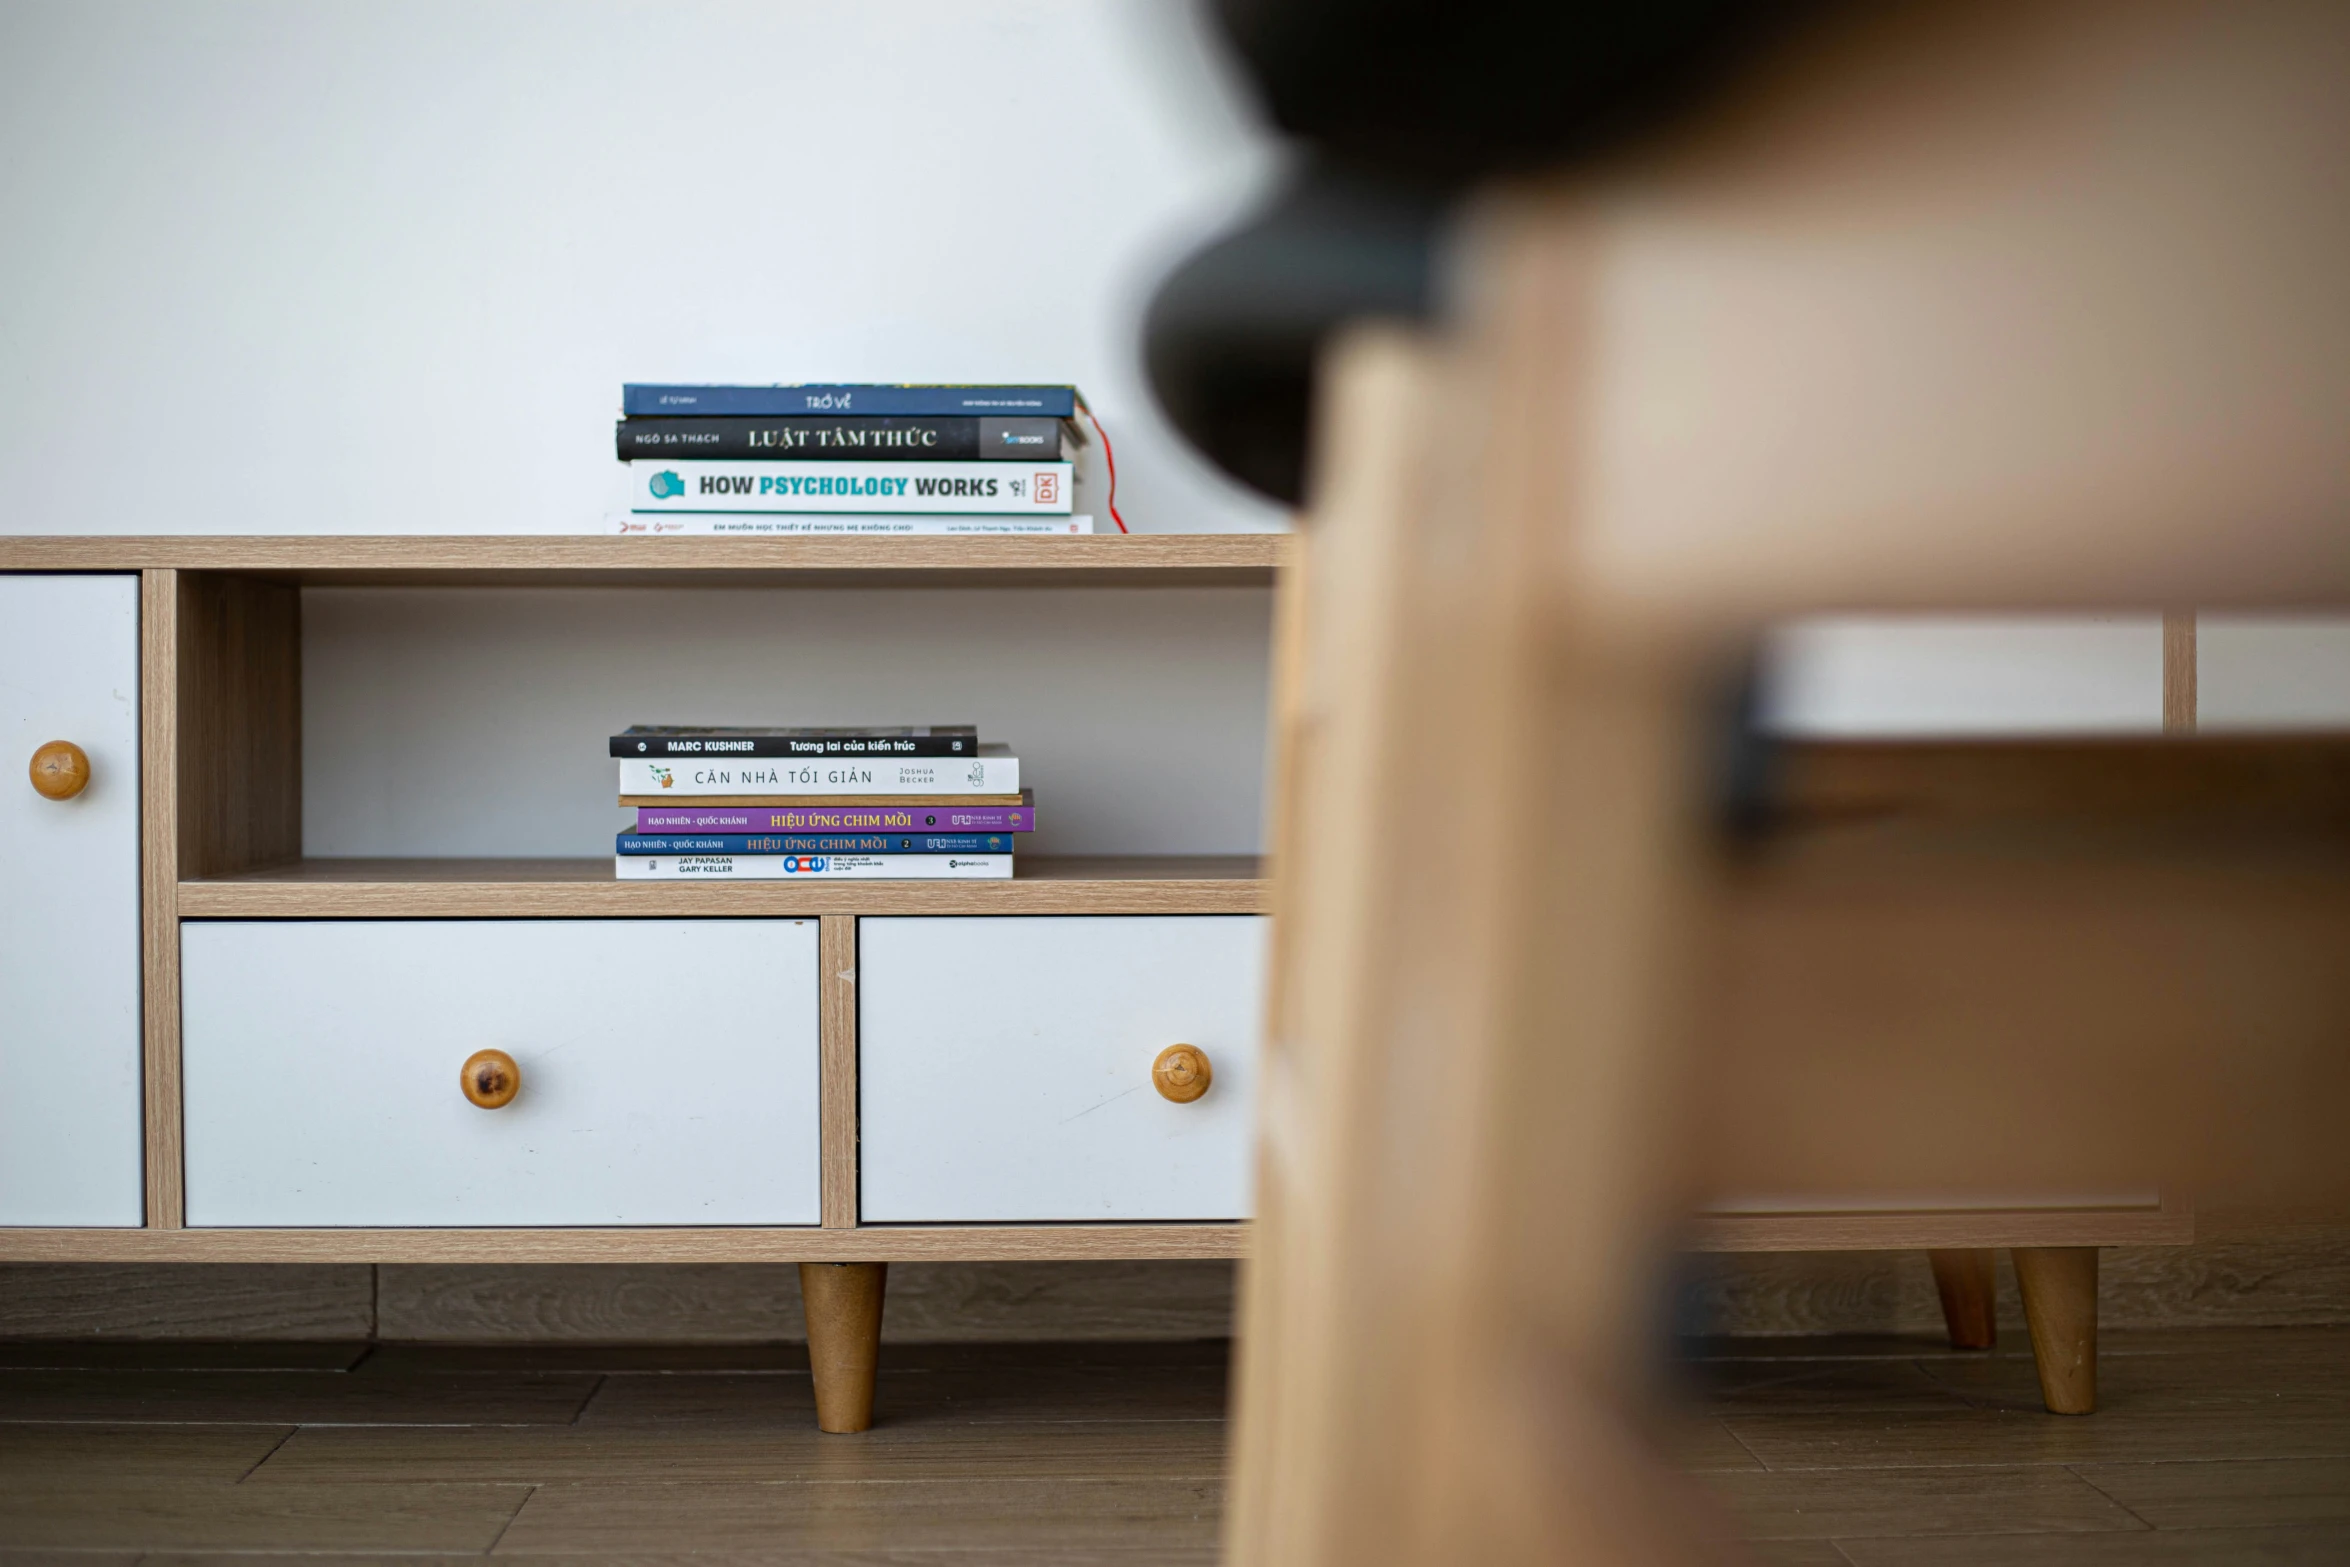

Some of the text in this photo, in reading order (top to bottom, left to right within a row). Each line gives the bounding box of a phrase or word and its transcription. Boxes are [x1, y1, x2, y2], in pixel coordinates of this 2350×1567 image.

[635, 433, 720, 445] NGÔ SA THẠCH
[749, 426, 937, 449] LUẬT TÂM THỨC
[700, 476, 754, 494] HOW
[760, 476, 908, 496] PSYCHOLOGY
[915, 477, 998, 496] WORKS
[1040, 477, 1053, 499] DK
[667, 741, 755, 752] MARC KUSHNER
[790, 739, 916, 753] Tương lai của kiến trúc
[695, 766, 872, 784] CĂN NHÀ TỐI GIẢN
[648, 817, 665, 826] HẠO
[666, 816, 691, 825] NHIÊN
[697, 815, 719, 826] QUỐC
[720, 816, 747, 825] KHÁNH
[771, 811, 911, 829] HIỆU ỨNG CHIM MỒI
[928, 816, 934, 825] 3
[624, 840, 641, 850] HẠO
[643, 839, 667, 849] NHIÊN
[673, 839, 694, 849] QUỐC
[696, 840, 723, 849] KHÁNH
[747, 836, 888, 851] HIỆU ỨNG CHIM MỒI
[903, 840, 909, 848] 2
[678, 857, 732, 865] JAY PAPASAN
